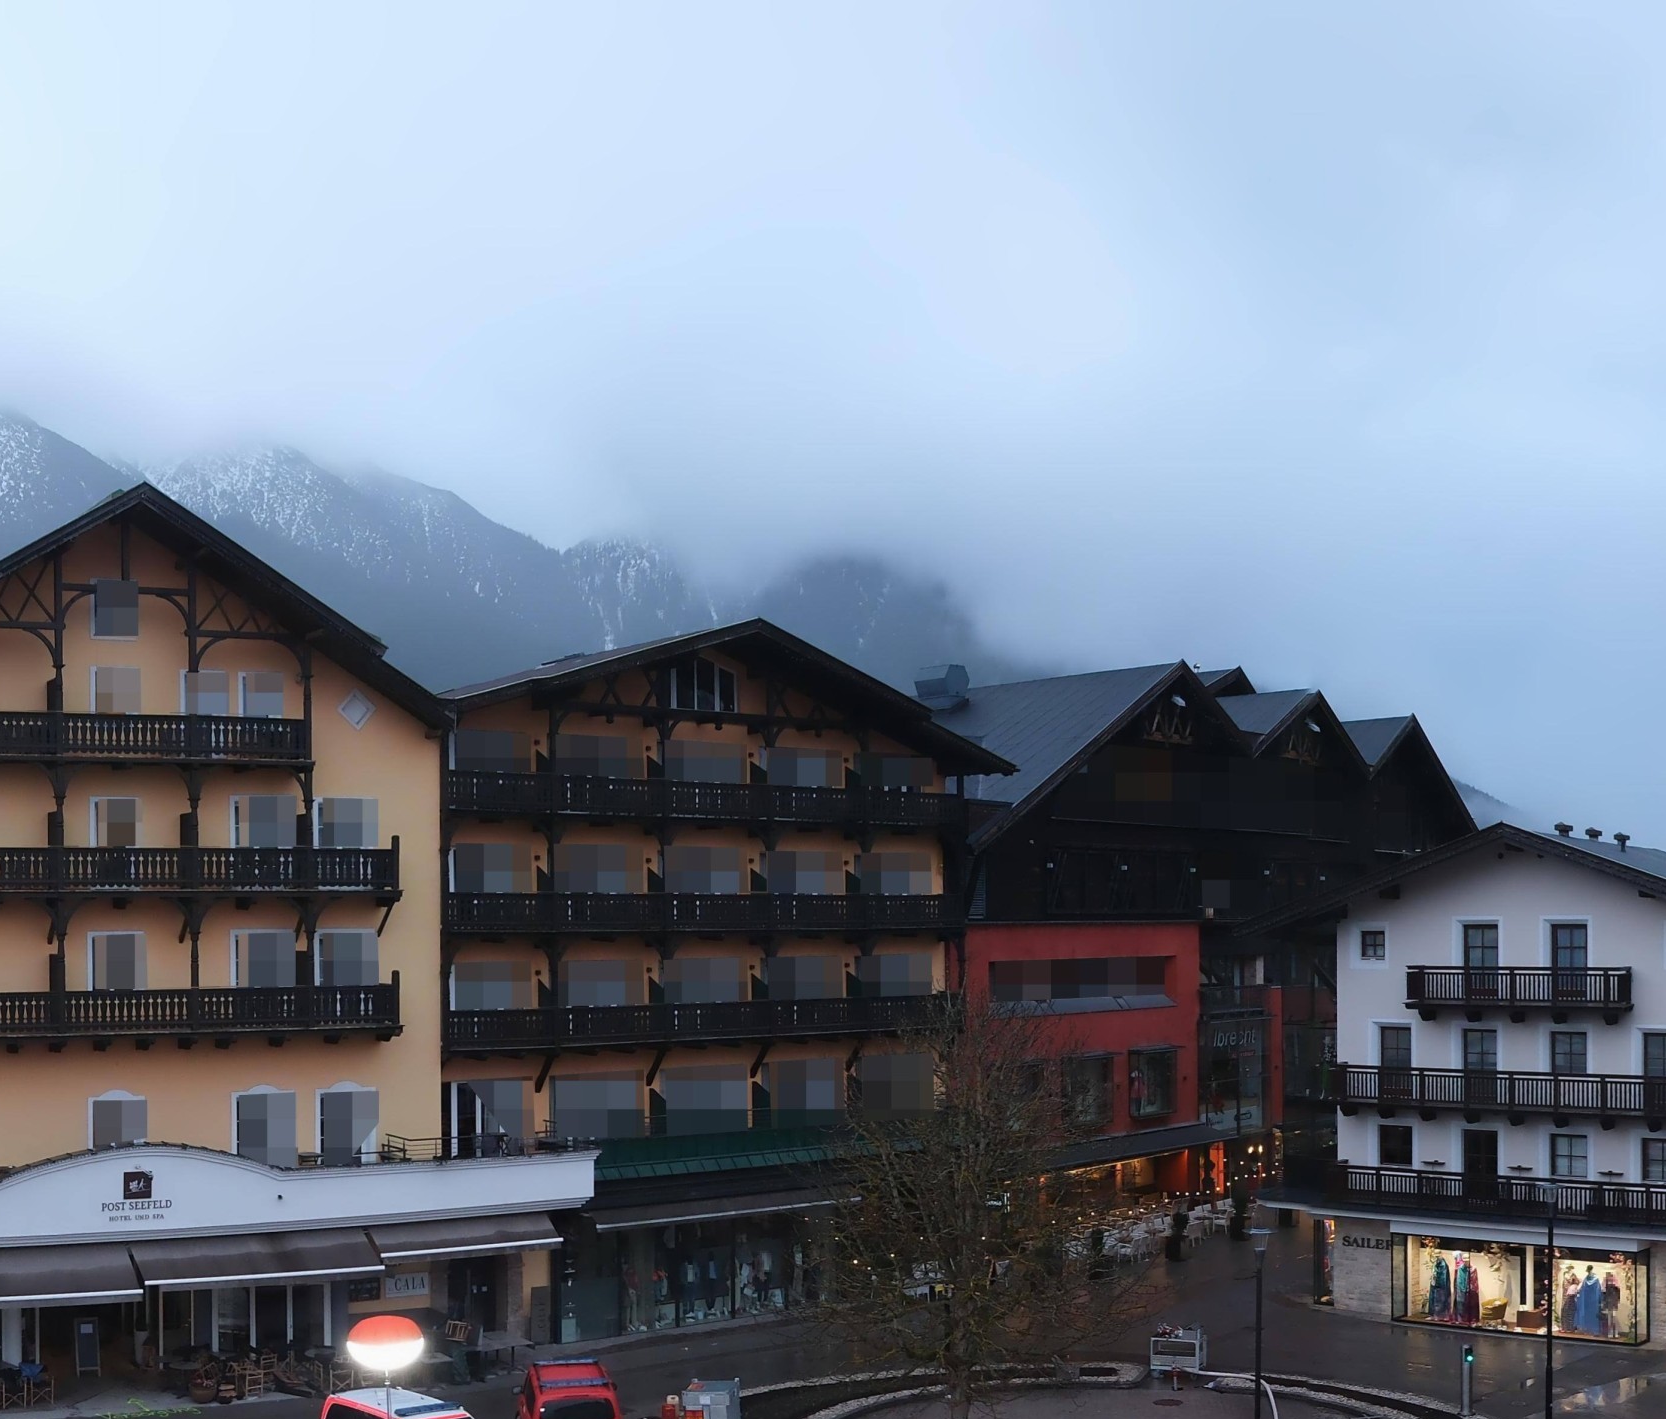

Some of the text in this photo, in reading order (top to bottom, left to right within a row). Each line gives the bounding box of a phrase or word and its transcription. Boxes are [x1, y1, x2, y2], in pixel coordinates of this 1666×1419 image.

[101, 1199, 173, 1212] POST SEEFELD
[108, 1214, 132, 1222] HOTEL
